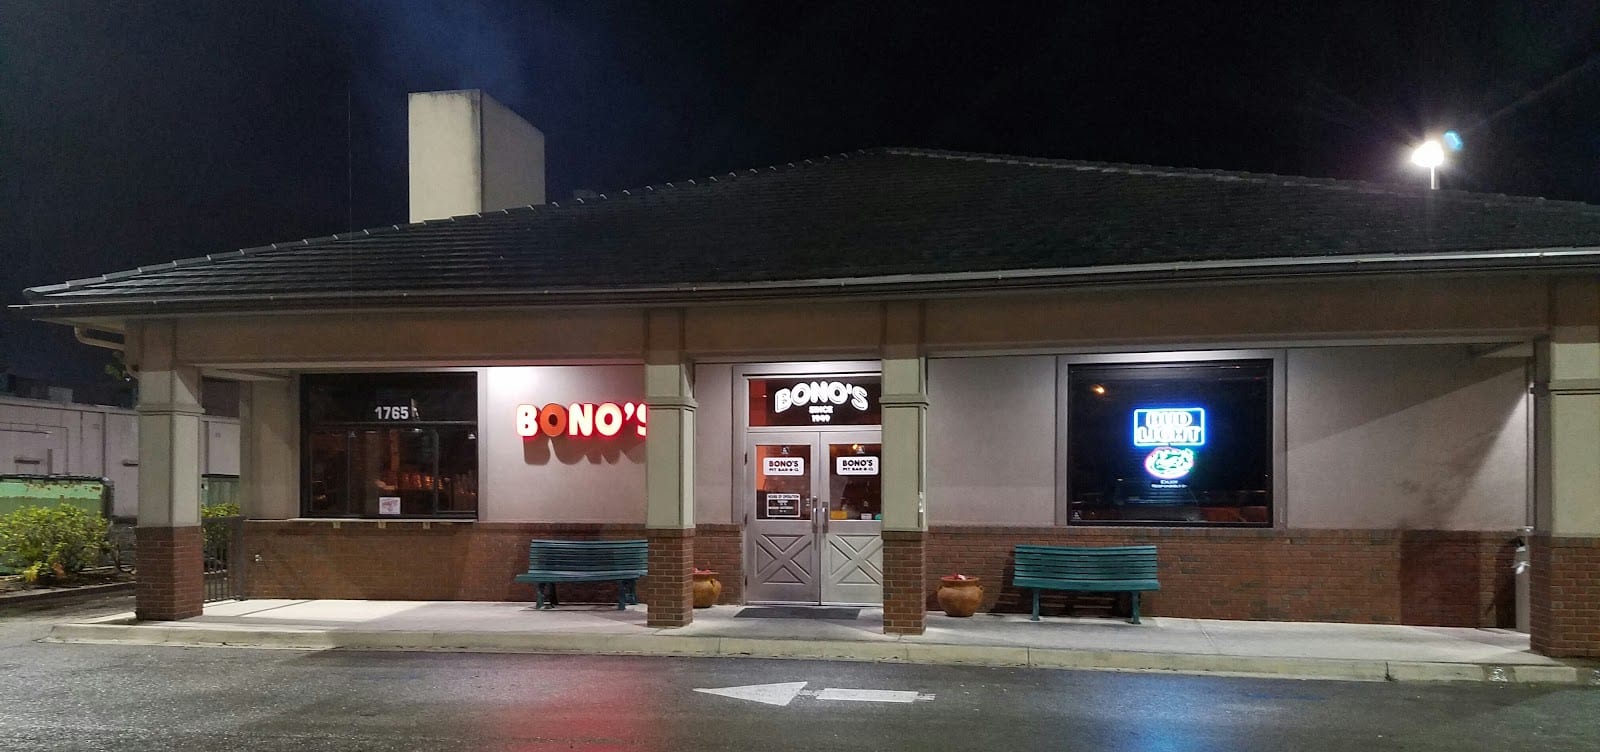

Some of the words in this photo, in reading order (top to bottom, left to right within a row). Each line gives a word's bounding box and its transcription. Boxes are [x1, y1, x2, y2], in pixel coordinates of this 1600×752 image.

[774, 381, 869, 413] BONO'S
[374, 406, 409, 420] 1765
[808, 405, 833, 413] SINCE
[811, 414, 831, 422] 1949
[1145, 411, 1193, 427] BUD
[1137, 426, 1201, 442] LIGHT
[842, 459, 873, 467] BONO'S
